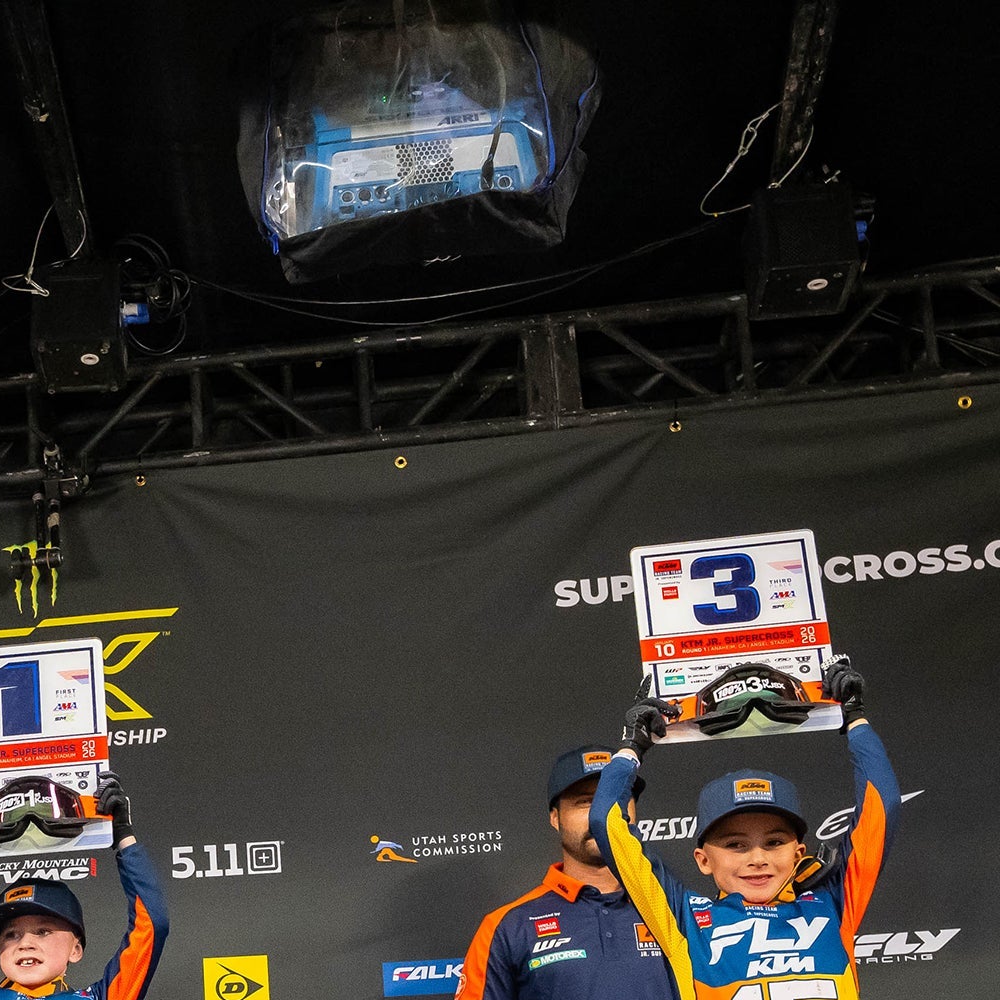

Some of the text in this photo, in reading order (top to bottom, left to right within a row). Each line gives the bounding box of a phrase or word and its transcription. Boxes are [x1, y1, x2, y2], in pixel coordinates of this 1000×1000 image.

[438, 112, 480, 126] ARRI
[690, 552, 761, 626] 3
[800, 626, 815, 636] 20
[681, 630, 794, 649] KTM JR. SUPERCROSS
[801, 634, 816, 644] 26
[654, 644, 675, 659] 10
[715, 677, 764, 700] 100% 3
[13, 744, 76, 757] SUPERCROSS
[81, 740, 95, 749] 20
[82, 748, 96, 758] 26
[24, 790, 35, 807] 1
[412, 831, 502, 846] UTAH SPORTS
[413, 843, 502, 857] COMMISSION
[23, 858, 89, 870] MOUNTAIN
[171, 844, 243, 879] 5.11
[8, 888, 29, 899] KTM
[532, 937, 572, 953] WP
[709, 917, 830, 965] FLY
[854, 928, 961, 957] FLY
[540, 949, 585, 964] MOTOREX
[393, 964, 464, 981] FALK
[746, 952, 815, 978] KTM
